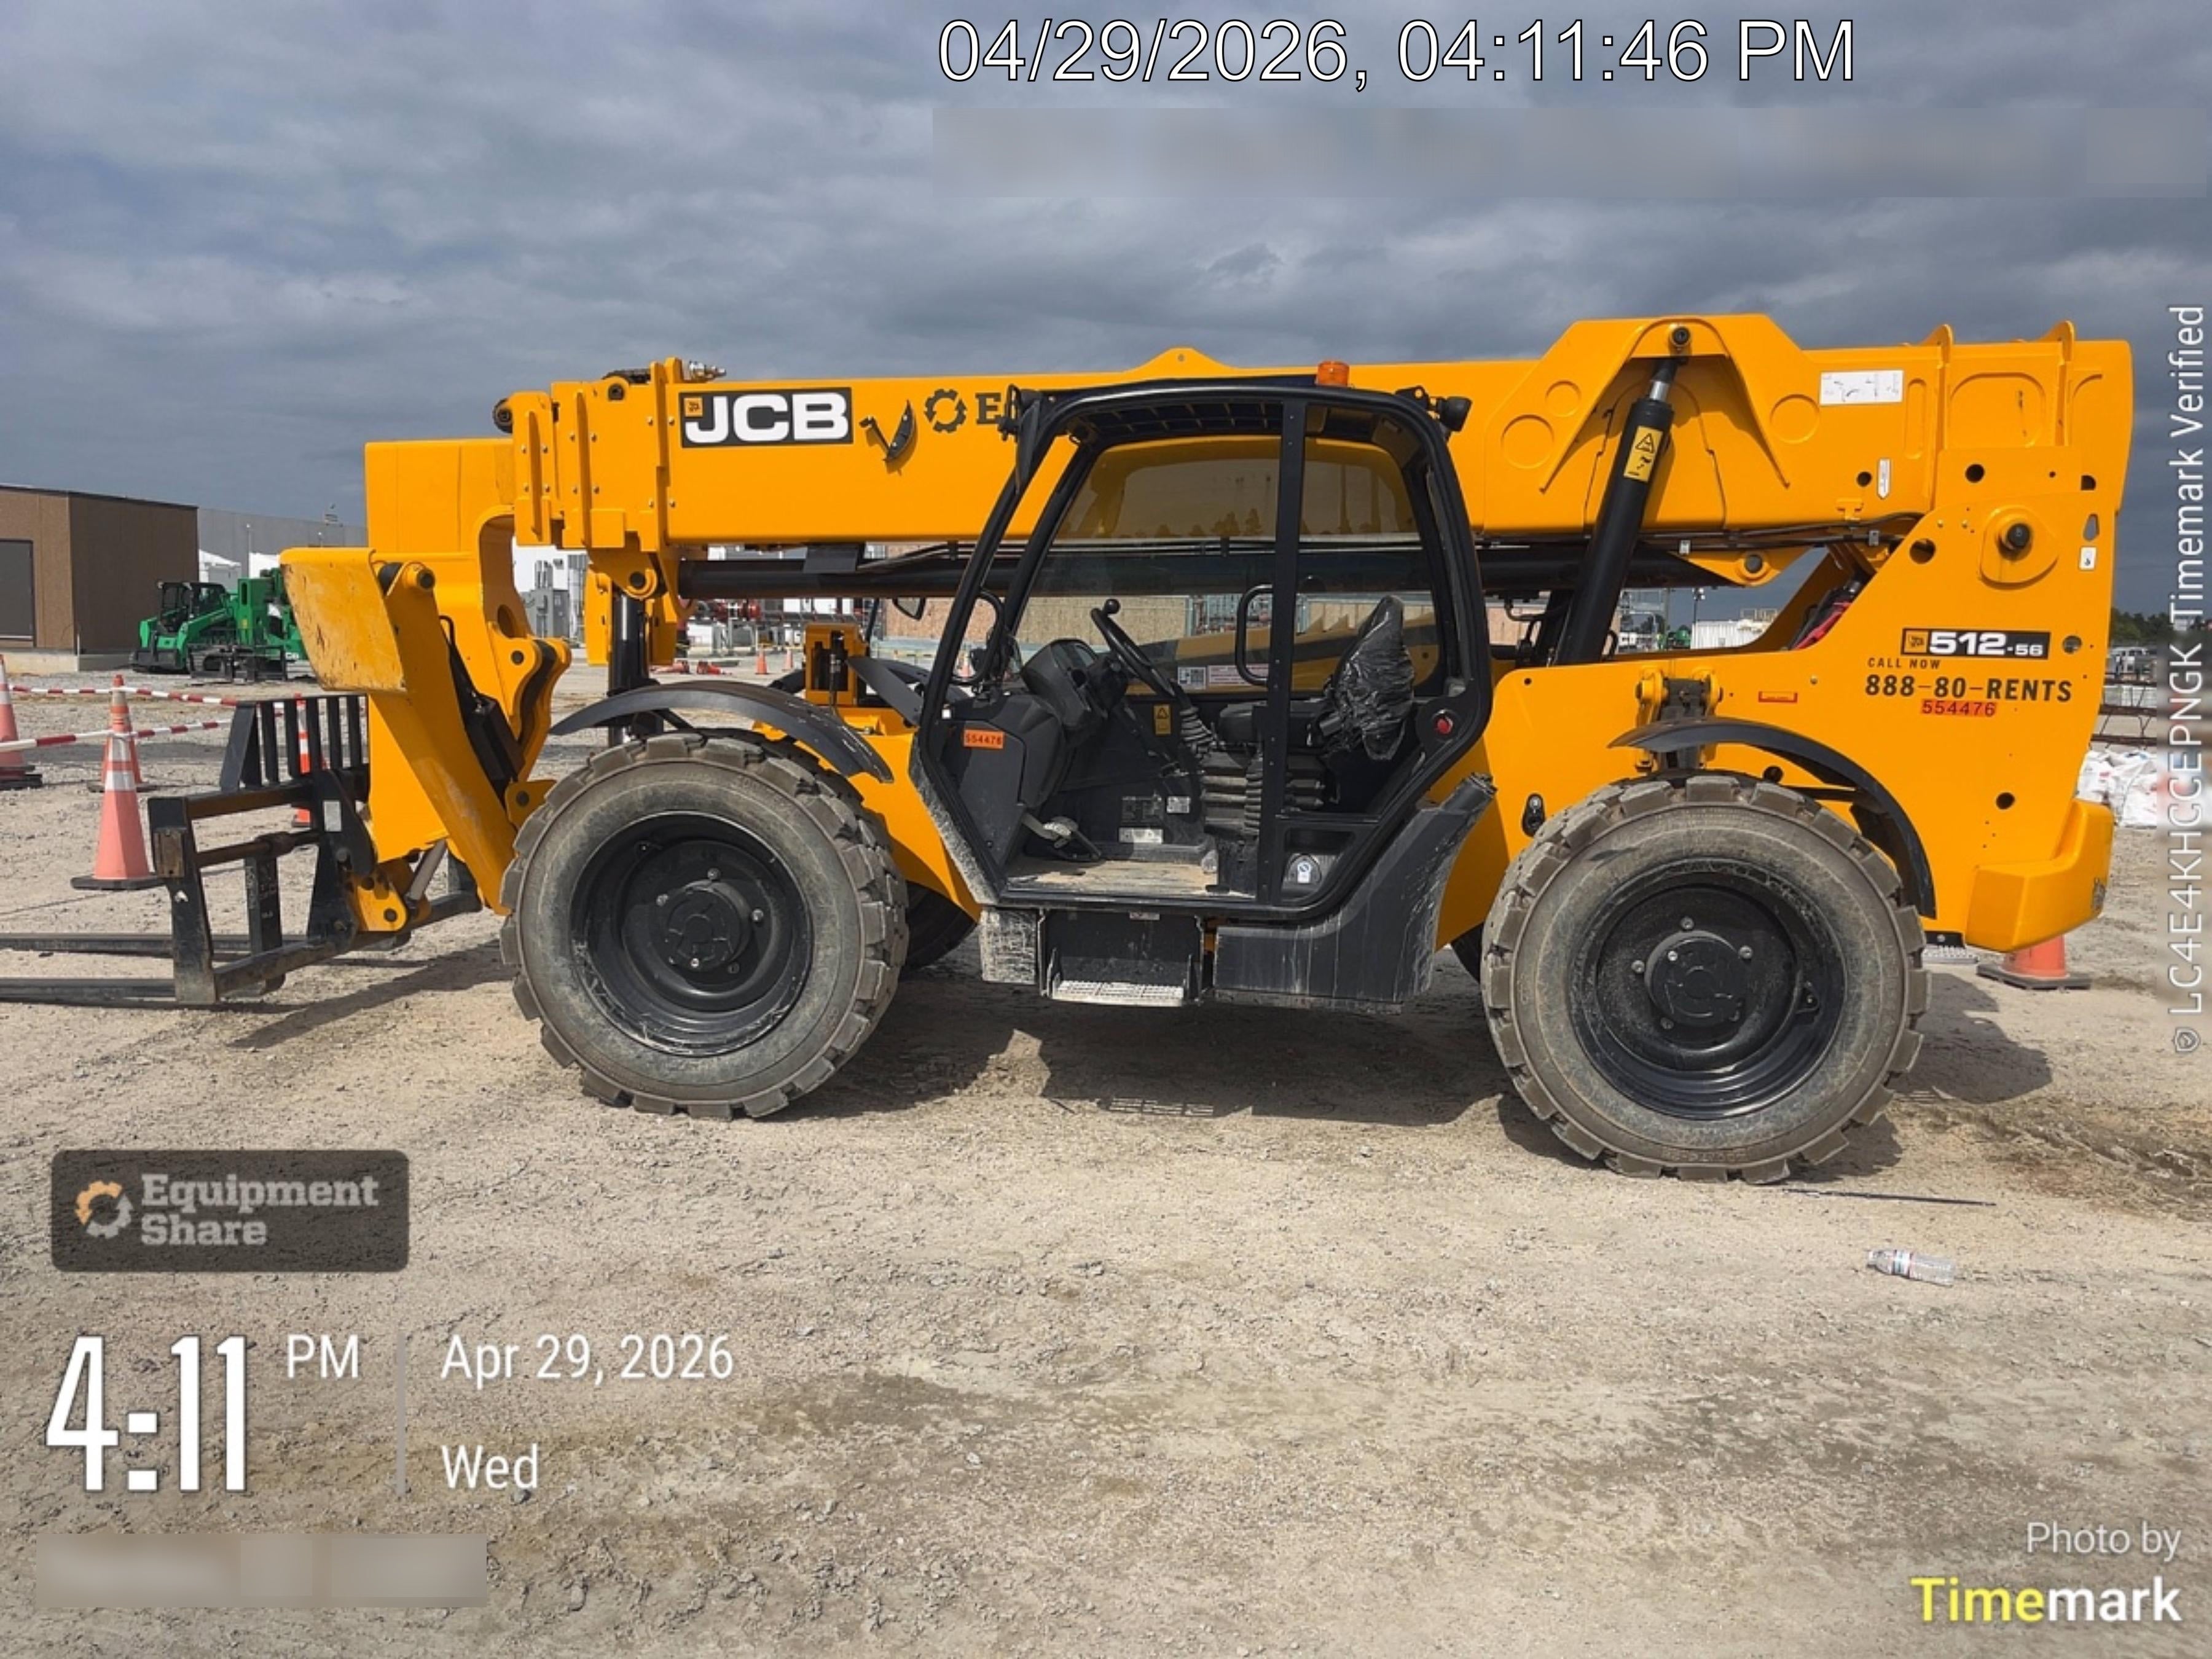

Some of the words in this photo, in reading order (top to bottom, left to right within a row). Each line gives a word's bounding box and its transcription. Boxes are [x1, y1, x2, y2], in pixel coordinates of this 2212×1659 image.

[684, 391, 850, 444] JCB
[1867, 657, 1902, 669] CALL
[1908, 659, 1940, 670] NOW
[1865, 674, 2073, 702] 888-80-RENTS
[1921, 700, 1997, 717] 554476
